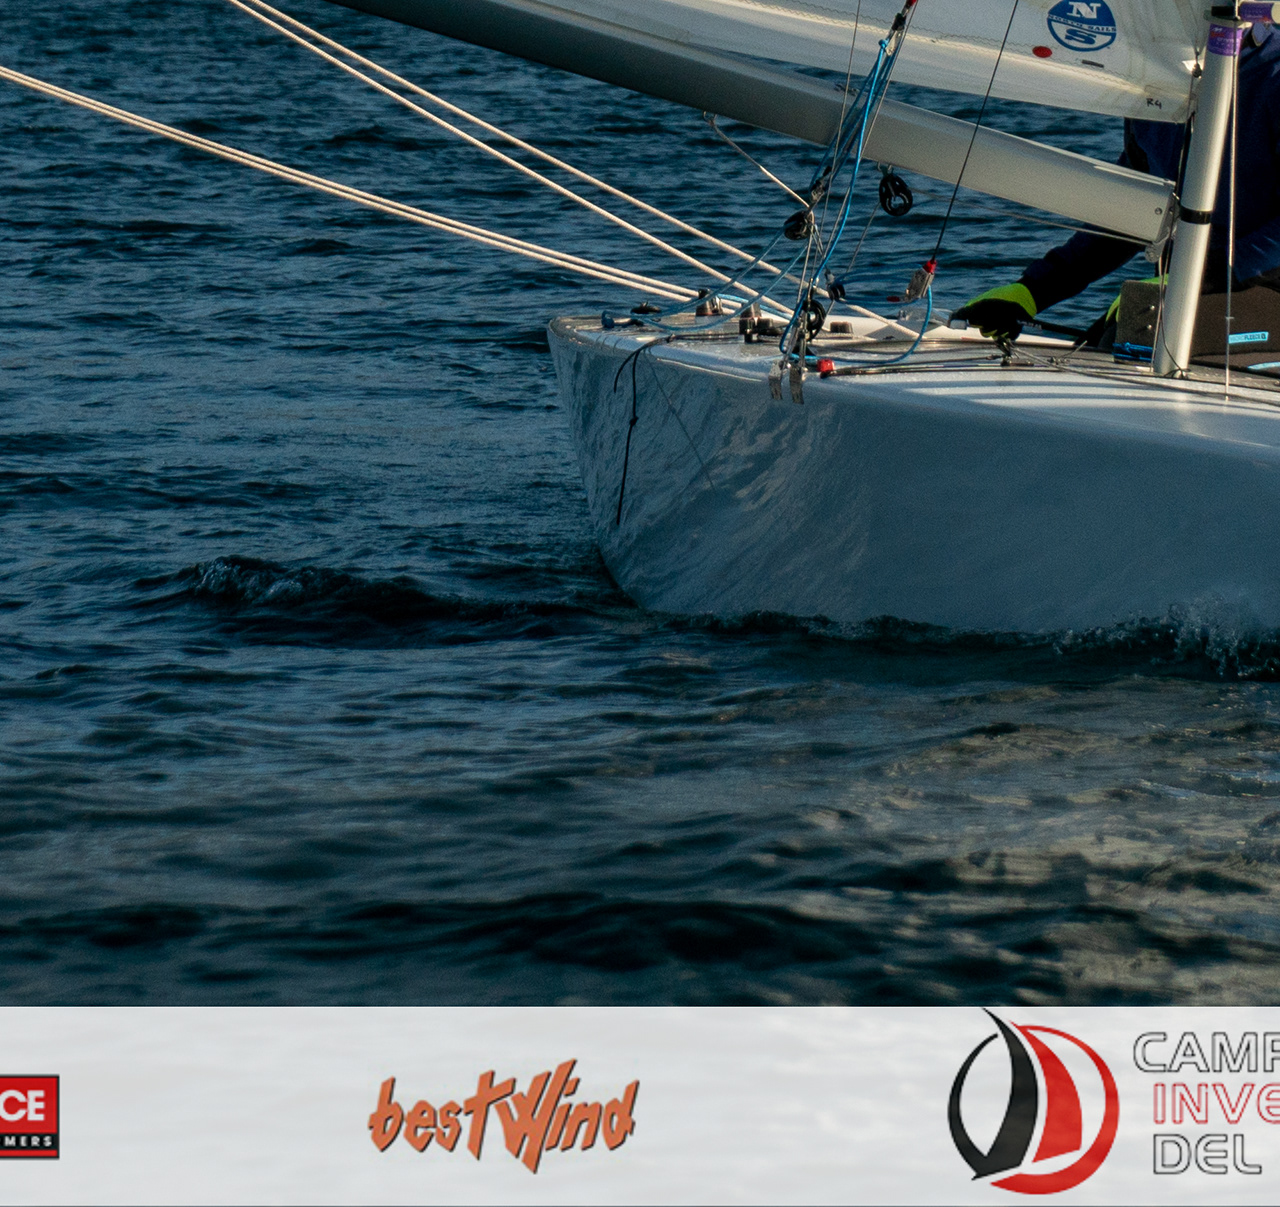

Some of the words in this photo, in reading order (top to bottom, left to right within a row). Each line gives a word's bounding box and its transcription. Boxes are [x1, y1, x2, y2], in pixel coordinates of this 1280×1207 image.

[1067, 1, 1102, 19] N
[1048, 14, 1083, 28] NORTH
[1064, 28, 1097, 45] S
